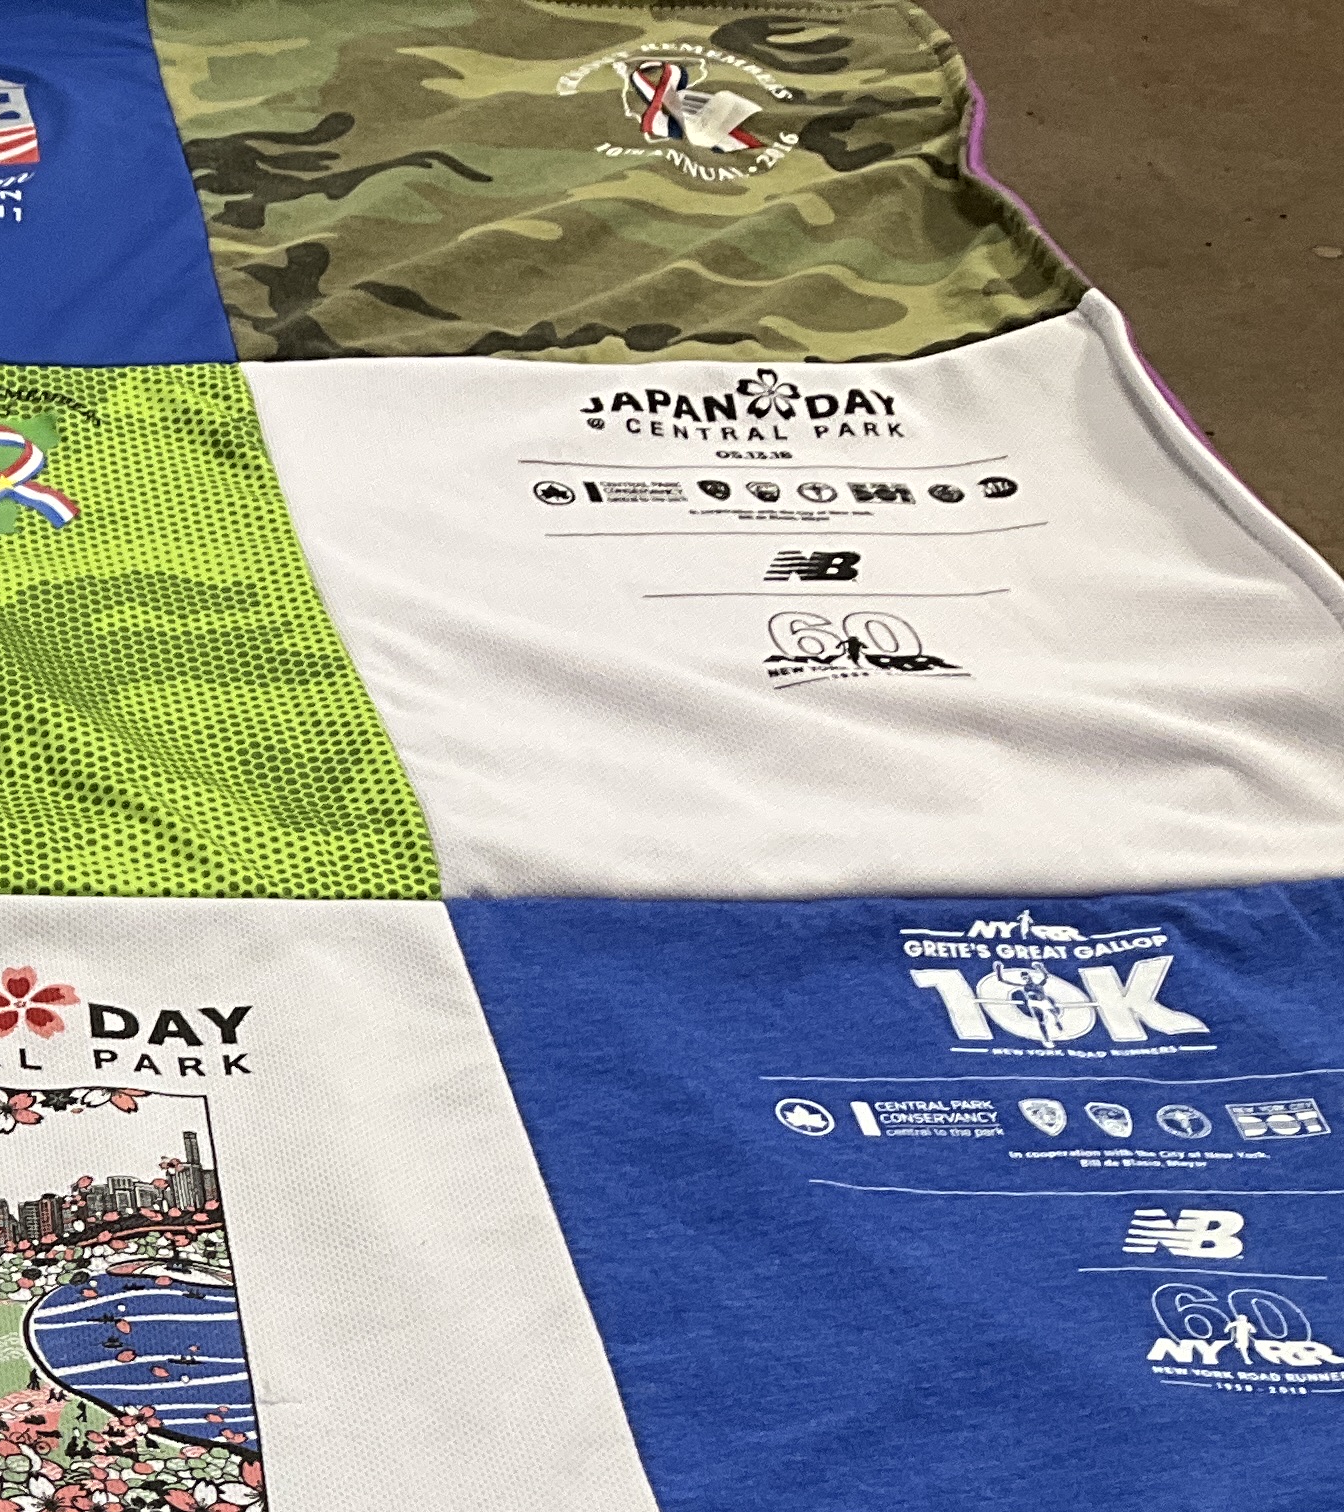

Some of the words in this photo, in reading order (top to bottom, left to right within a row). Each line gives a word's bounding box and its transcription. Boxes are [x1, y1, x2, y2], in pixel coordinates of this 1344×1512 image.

[580, 389, 737, 421] JAPAN
[805, 388, 898, 418] DAY
[626, 417, 789, 441] CENTRAL
[815, 422, 908, 438] PARK
[903, 940, 992, 959] GRETE'S
[996, 943, 1068, 960] GREAT
[1073, 935, 1168, 959] GALLOP
[910, 955, 1210, 1042] 10K
[88, 1002, 252, 1047] DAY
[93, 1049, 252, 1077] PARK
[874, 1101, 945, 1112] CENTRAL
[950, 1100, 995, 1111] PARK
[879, 1111, 998, 1124] CONSERVANCY
